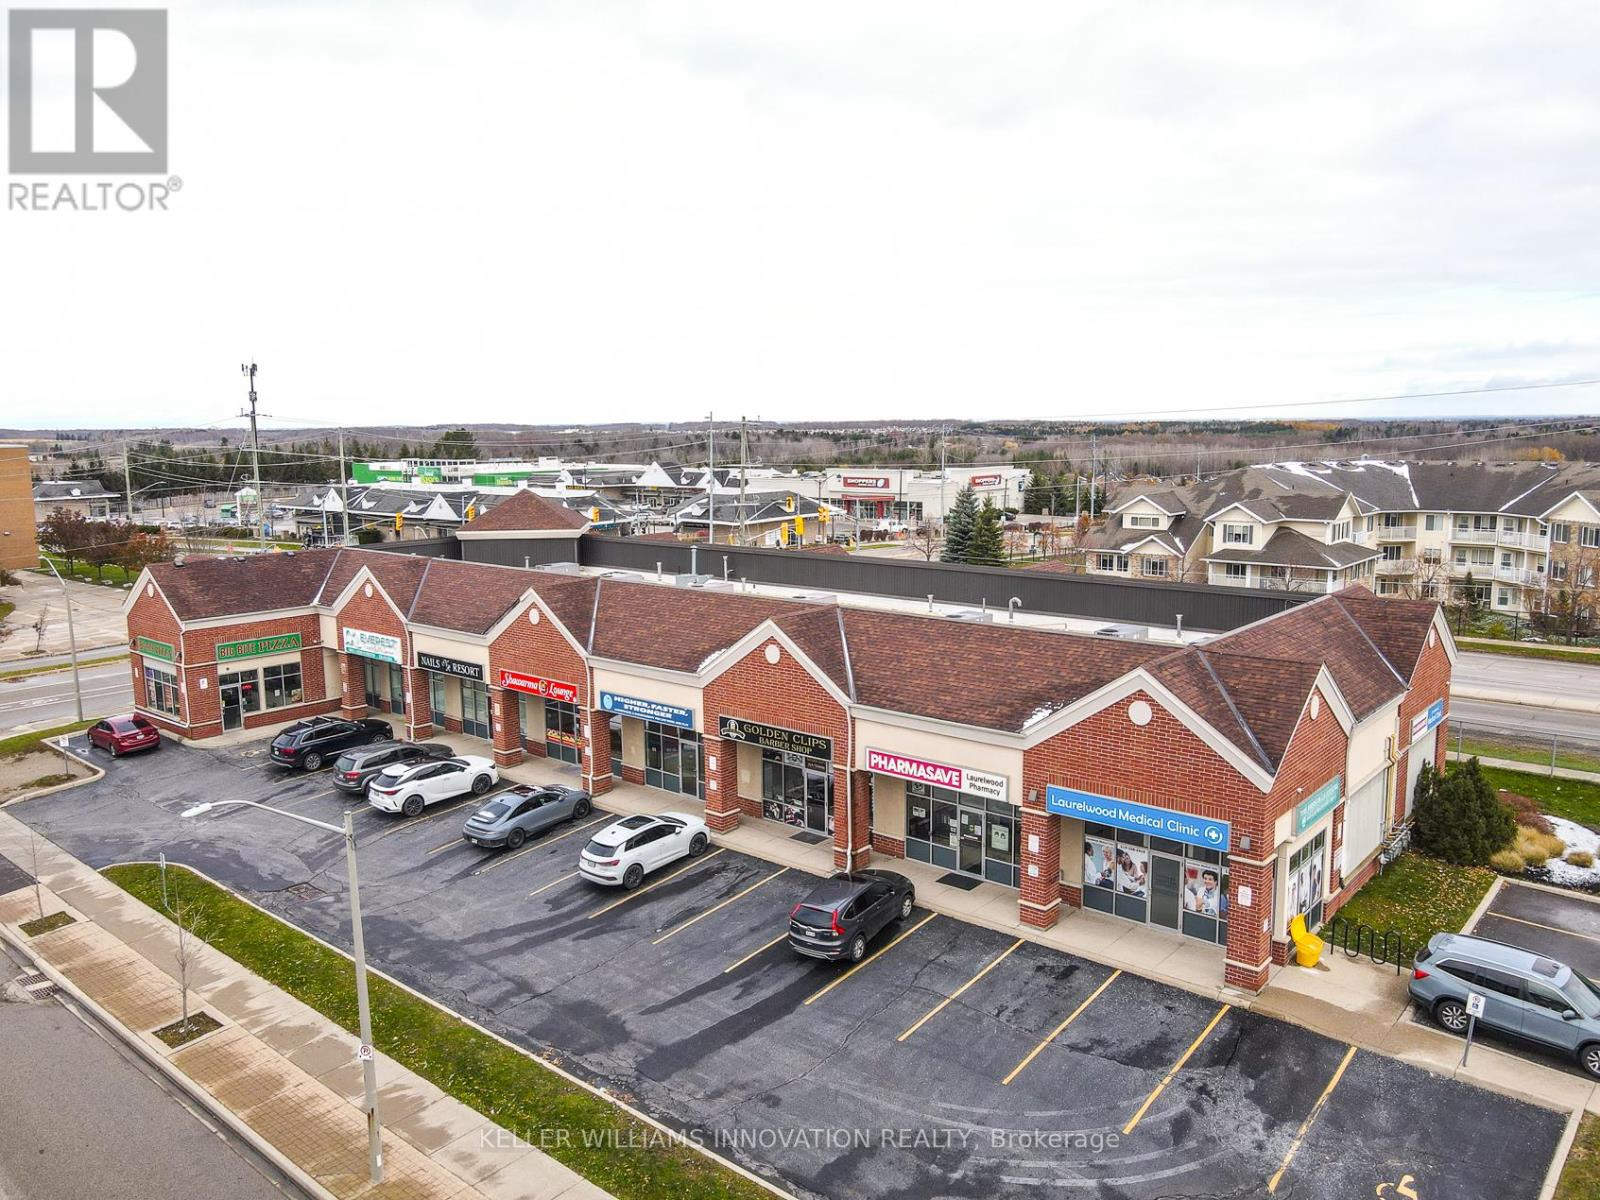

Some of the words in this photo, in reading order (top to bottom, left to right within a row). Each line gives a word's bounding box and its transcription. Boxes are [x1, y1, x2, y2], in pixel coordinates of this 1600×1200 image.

[220, 646, 235, 658] BIG
[237, 642, 256, 655] BITE
[257, 636, 299, 652] PIZZA
[421, 656, 441, 668] NAILS
[452, 663, 480, 677] RESORT
[549, 683, 573, 700] Lounge
[623, 704, 673, 719] STRONGER
[743, 723, 789, 741] GOLDEN
[792, 734, 827, 749] CLIPS
[759, 736, 790, 750] BARBER
[791, 743, 812, 754] SHOP
[870, 753, 961, 785] PHARMASAVE
[966, 773, 1004, 788] Laurelwood
[969, 783, 1001, 796] Pharmacy
[1051, 794, 1117, 819] Laurelwood
[1118, 809, 1164, 829] Medical
[1166, 819, 1200, 837] Clinic
